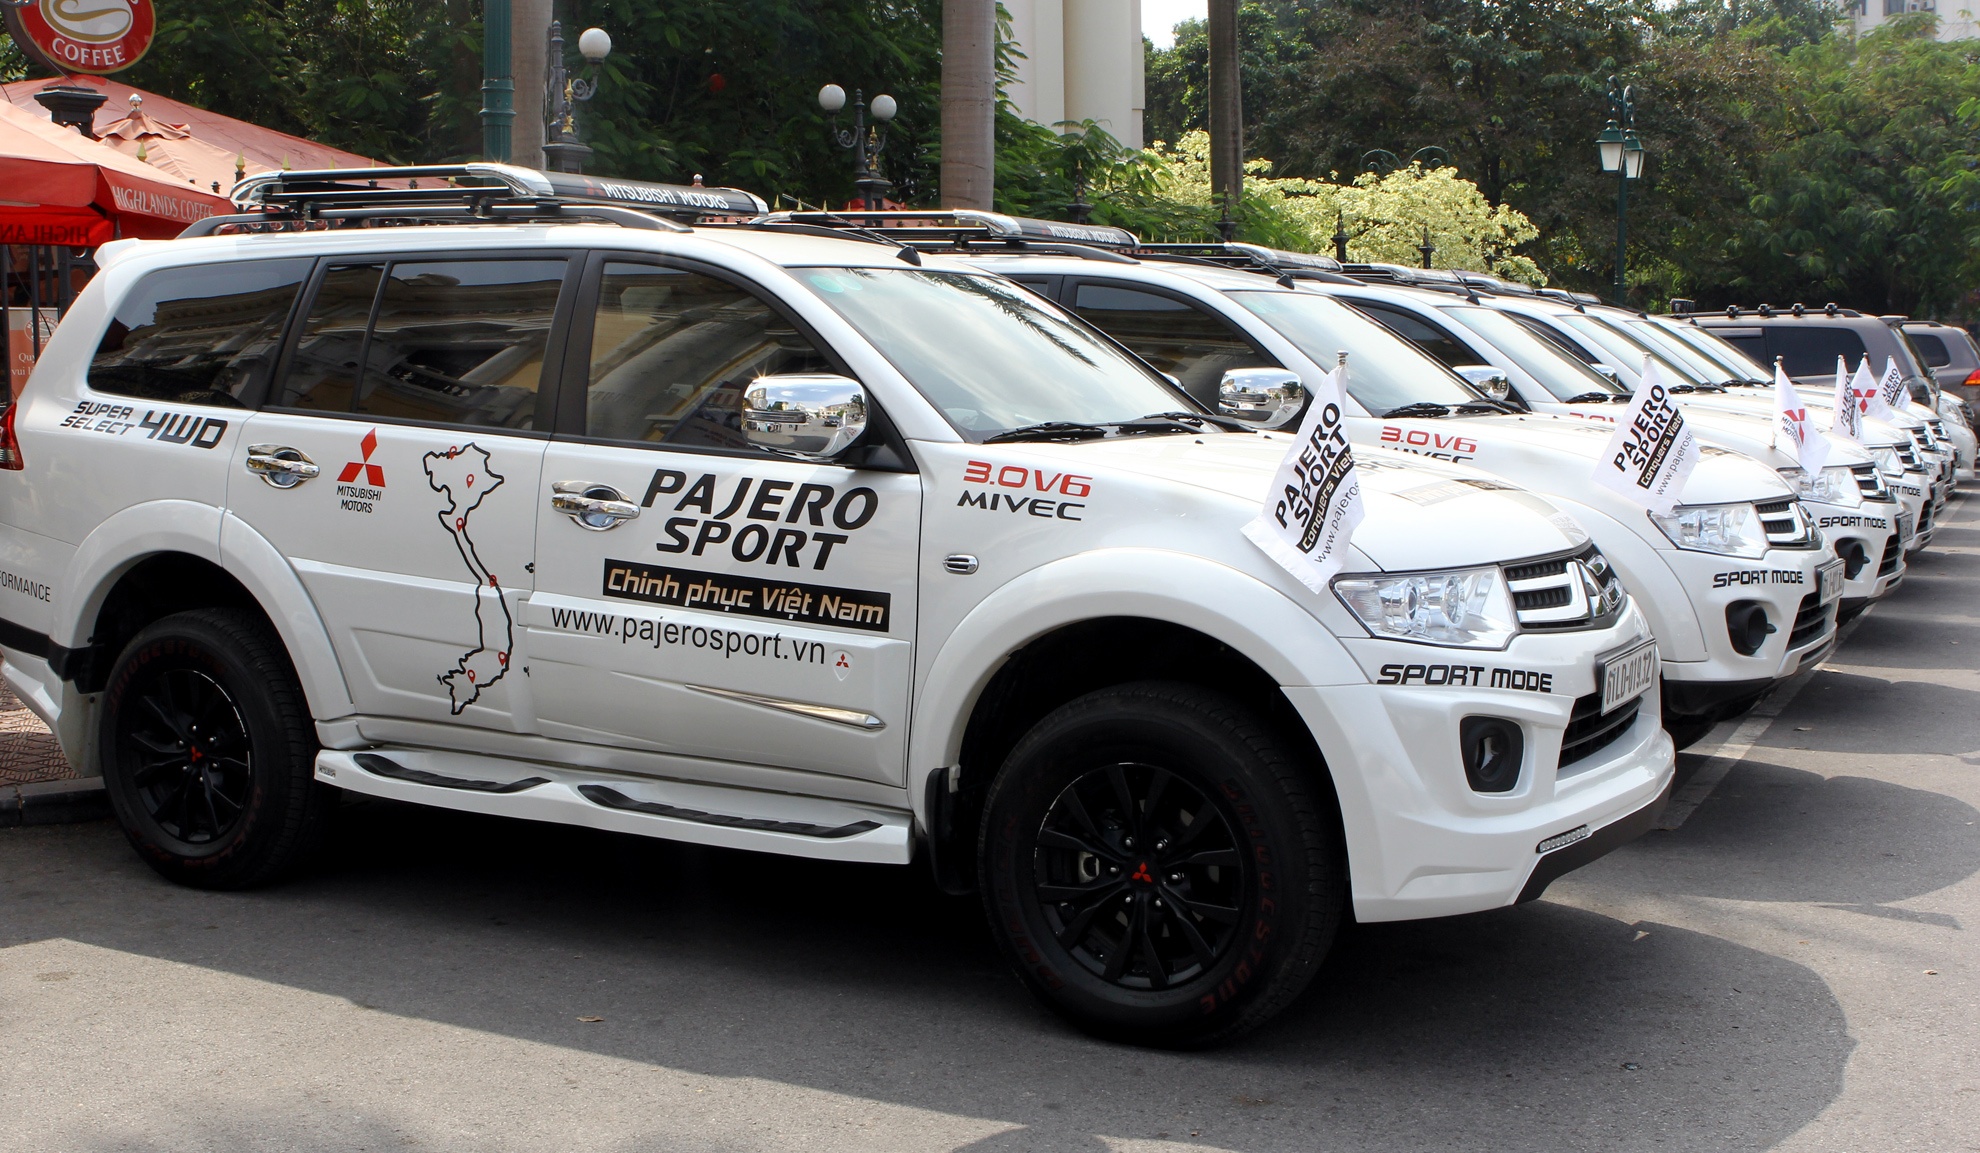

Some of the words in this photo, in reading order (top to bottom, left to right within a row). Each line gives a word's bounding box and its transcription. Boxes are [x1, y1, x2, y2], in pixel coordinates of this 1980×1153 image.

[52, 38, 125, 66] COFFEE
[111, 186, 178, 217] HIGHLANDS
[600, 183, 678, 204] MITSUBISHI
[677, 191, 730, 210] MOTORS
[59, 416, 135, 436] SELECT
[73, 401, 135, 421] SUPER
[137, 410, 228, 449] 4WD
[1381, 426, 1477, 453] 3.0V6
[1613, 384, 1665, 473] PAJERO
[1632, 399, 1673, 471] SPORT
[962, 460, 1093, 498] 3.0V6
[1275, 402, 1341, 529] PAJERO
[1294, 424, 1346, 528] SPORT
[1640, 437, 1671, 487] Conquers
[336, 485, 382, 501] MITSUBISHI
[340, 499, 373, 514] MOTORS
[640, 468, 879, 530] PAJERO
[956, 490, 1086, 521] MIVEC
[1301, 481, 1335, 550] Conquers
[1819, 516, 1861, 528] SPORT
[1864, 517, 1887, 529] MODE
[656, 516, 849, 571] SPORT
[1713, 569, 1768, 588] SPORT
[1771, 570, 1803, 584] MODE
[607, 568, 679, 600] Chinh
[684, 579, 754, 612] phục
[762, 587, 811, 620] Việt
[817, 594, 885, 625] Nam
[551, 606, 825, 665] www.pajerosport.vn
[1377, 664, 1485, 686] SPORT
[1490, 667, 1552, 693] MODE
